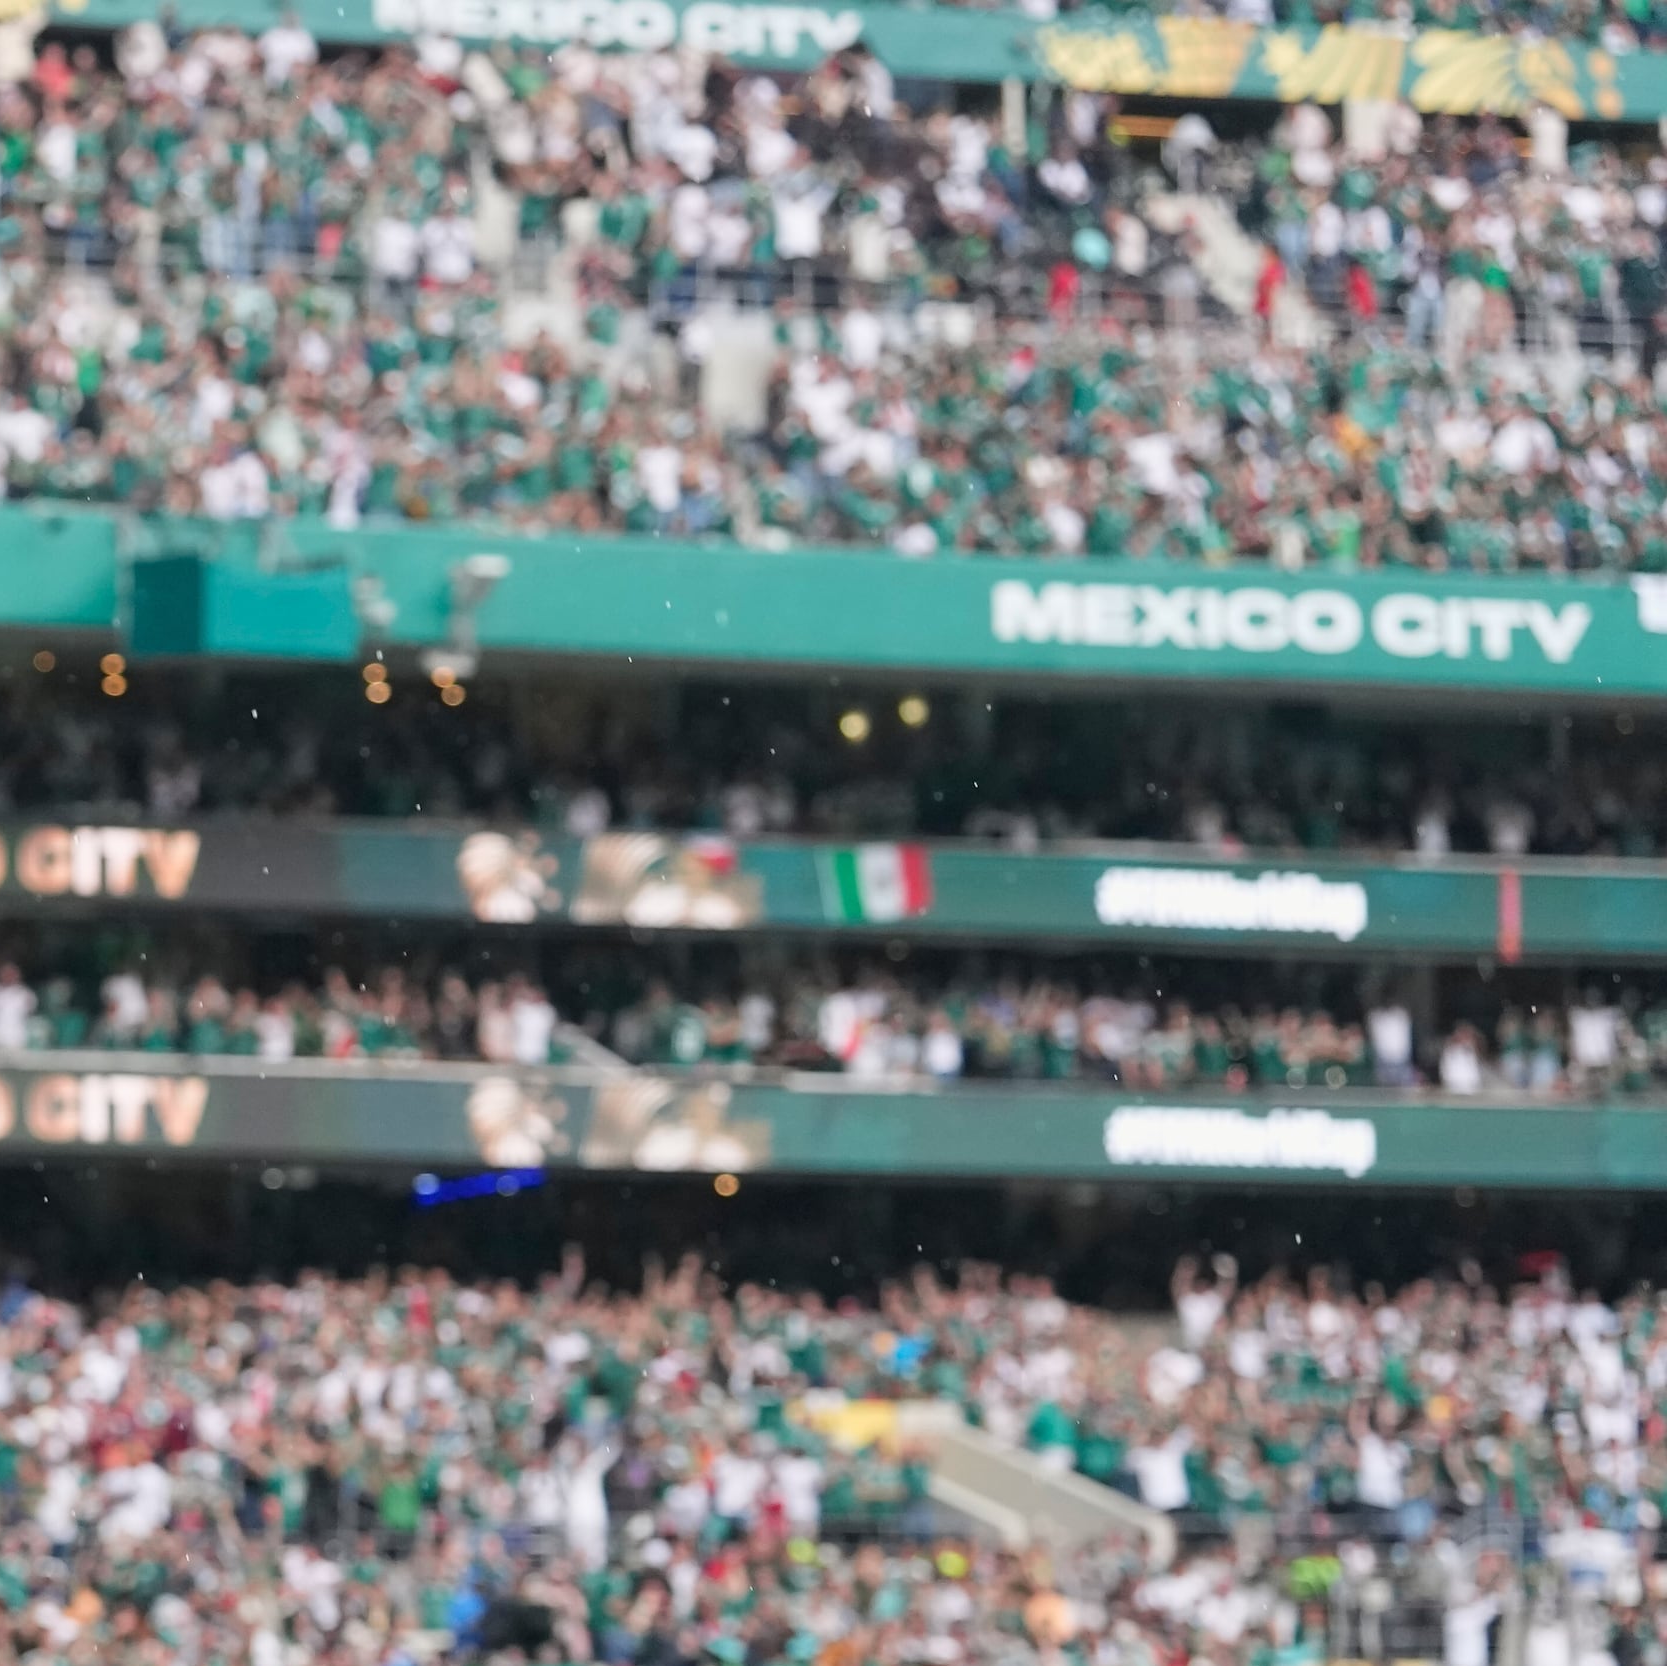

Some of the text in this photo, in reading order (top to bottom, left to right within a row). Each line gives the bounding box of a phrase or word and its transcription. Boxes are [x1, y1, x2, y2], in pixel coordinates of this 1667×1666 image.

[989, 579, 1593, 664] MEXICO CITY
[16, 824, 201, 899] CITY
[23, 1072, 210, 1146] CITY
